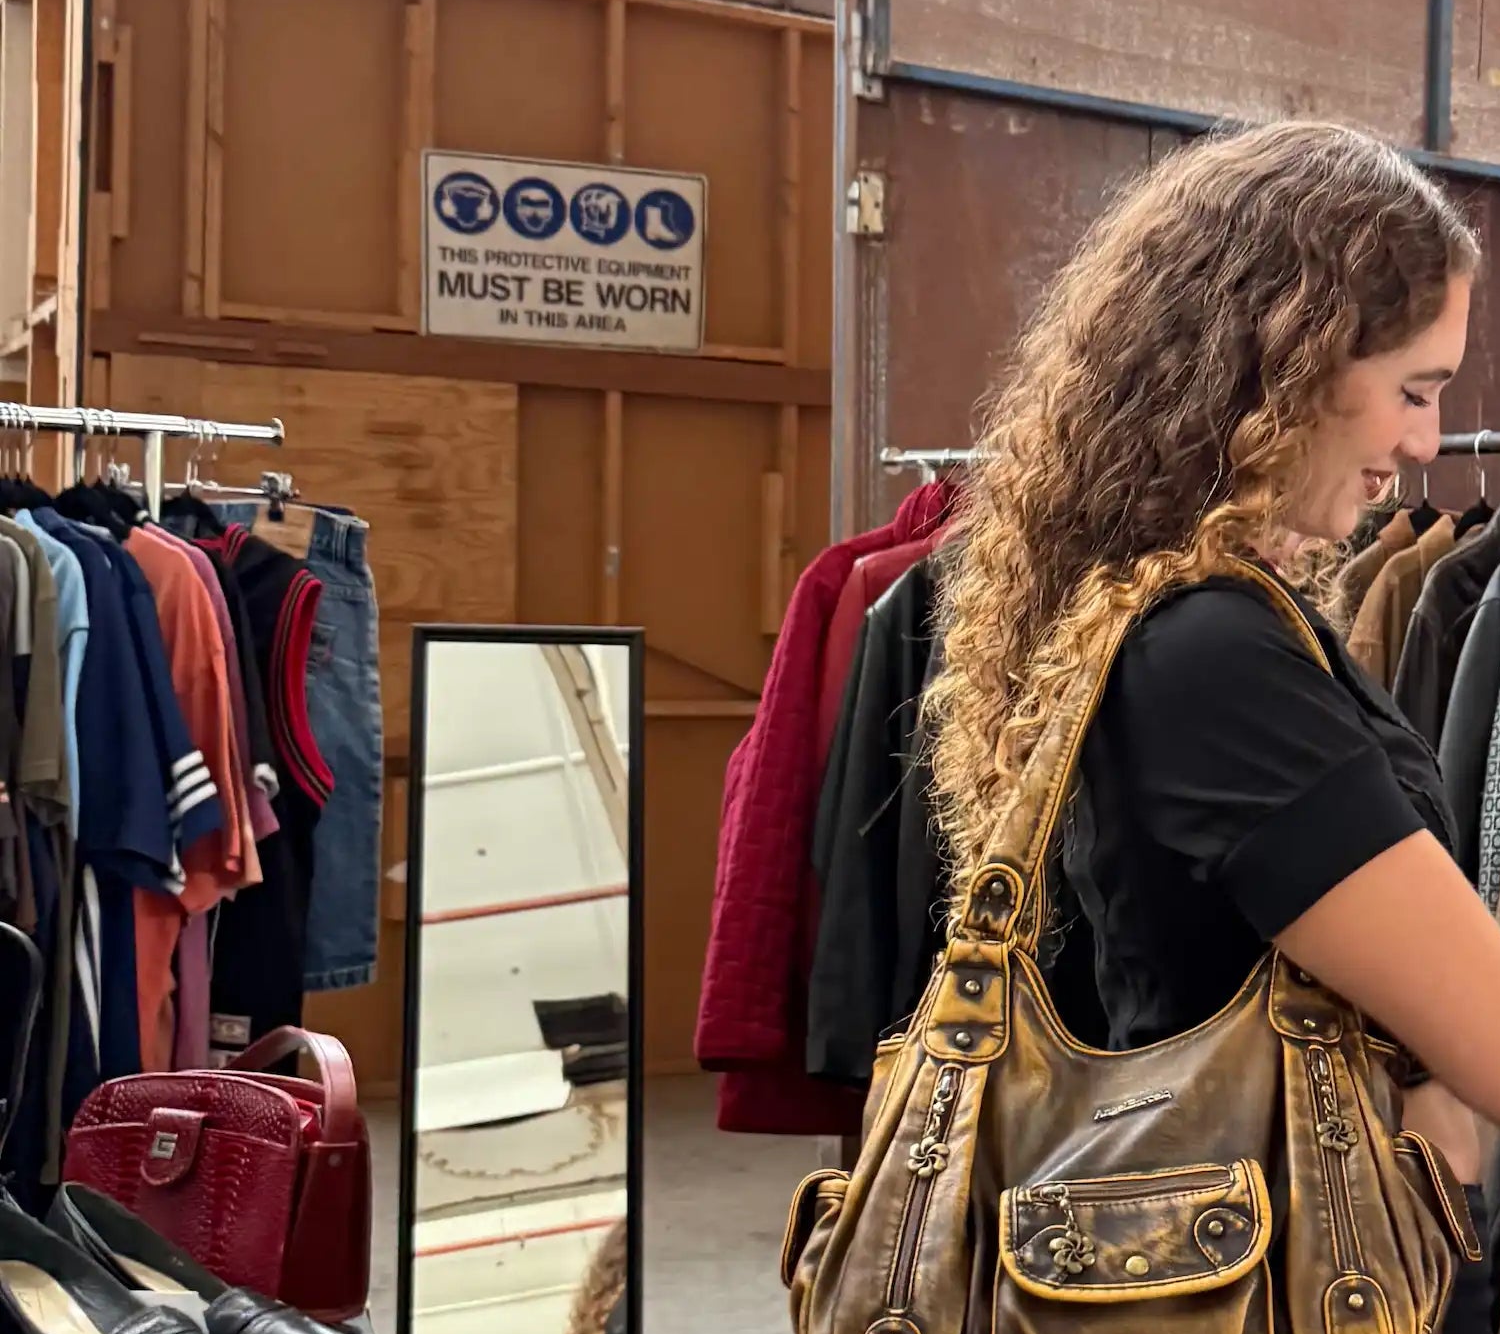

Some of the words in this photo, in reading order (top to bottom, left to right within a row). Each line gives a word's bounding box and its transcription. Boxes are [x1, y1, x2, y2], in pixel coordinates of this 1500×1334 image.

[438, 246, 479, 265] THIS
[485, 250, 592, 273] PROTECTIVE
[598, 258, 693, 281] EQUIPMENT
[438, 270, 530, 302] MUST
[543, 277, 584, 306] BE
[596, 283, 692, 314] WORN
[500, 309, 518, 325] IN
[524, 310, 568, 328] THIS
[575, 314, 627, 332] AREA
[151, 1130, 178, 1159] G
